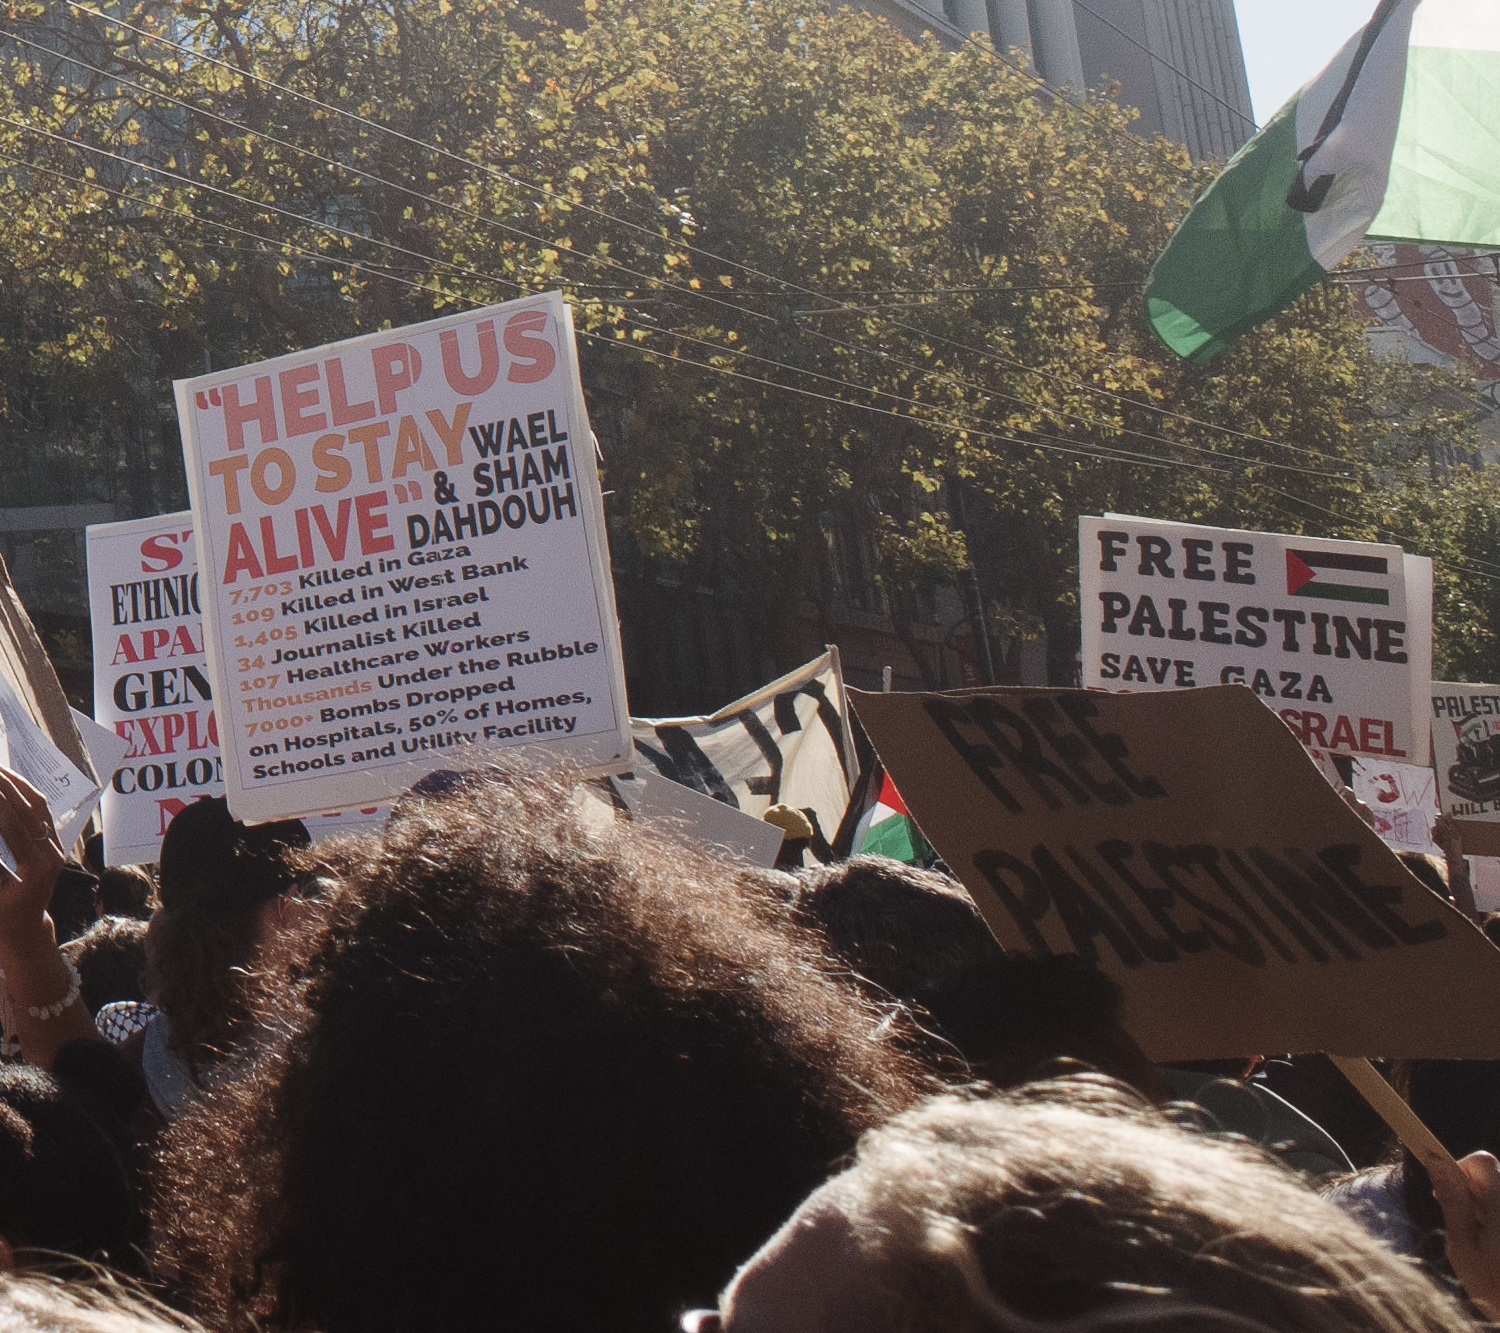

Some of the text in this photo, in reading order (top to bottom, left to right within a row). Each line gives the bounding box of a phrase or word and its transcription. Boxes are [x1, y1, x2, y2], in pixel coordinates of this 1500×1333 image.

[438, 310, 556, 396] US
[208, 401, 473, 515] TO STAY
[468, 409, 568, 459] WAEL
[433, 444, 571, 506] & SHAM
[406, 482, 577, 549] DAHDOUH
[229, 545, 471, 605] 7,703 Killed in Gaza
[1098, 531, 1256, 585] FREE
[232, 555, 529, 626] 109 Killed in West Bank
[234, 586, 489, 648] 1,405 Killed in Israel
[238, 612, 482, 673] 34 Journalist Killed
[1099, 592, 1408, 664] PALESTINE
[239, 629, 531, 692] 107 Healthcare Workers
[241, 638, 600, 713] Thousands Under the Rubble
[1100, 653, 1333, 703] SAVE GAZA
[249, 688, 592, 759] on Hospitals, 50% of Homes,
[319, 696, 401, 724] Bombs
[406, 675, 516, 708] Dropped
[1431, 695, 1500, 718] PALEST
[252, 715, 577, 779] Schools and Utility Facility
[921, 695, 1168, 815] FREE
[1275, 708, 1407, 758] SRAEL
[1451, 802, 1488, 816] WILL
[972, 839, 1451, 968] PALESTINE
